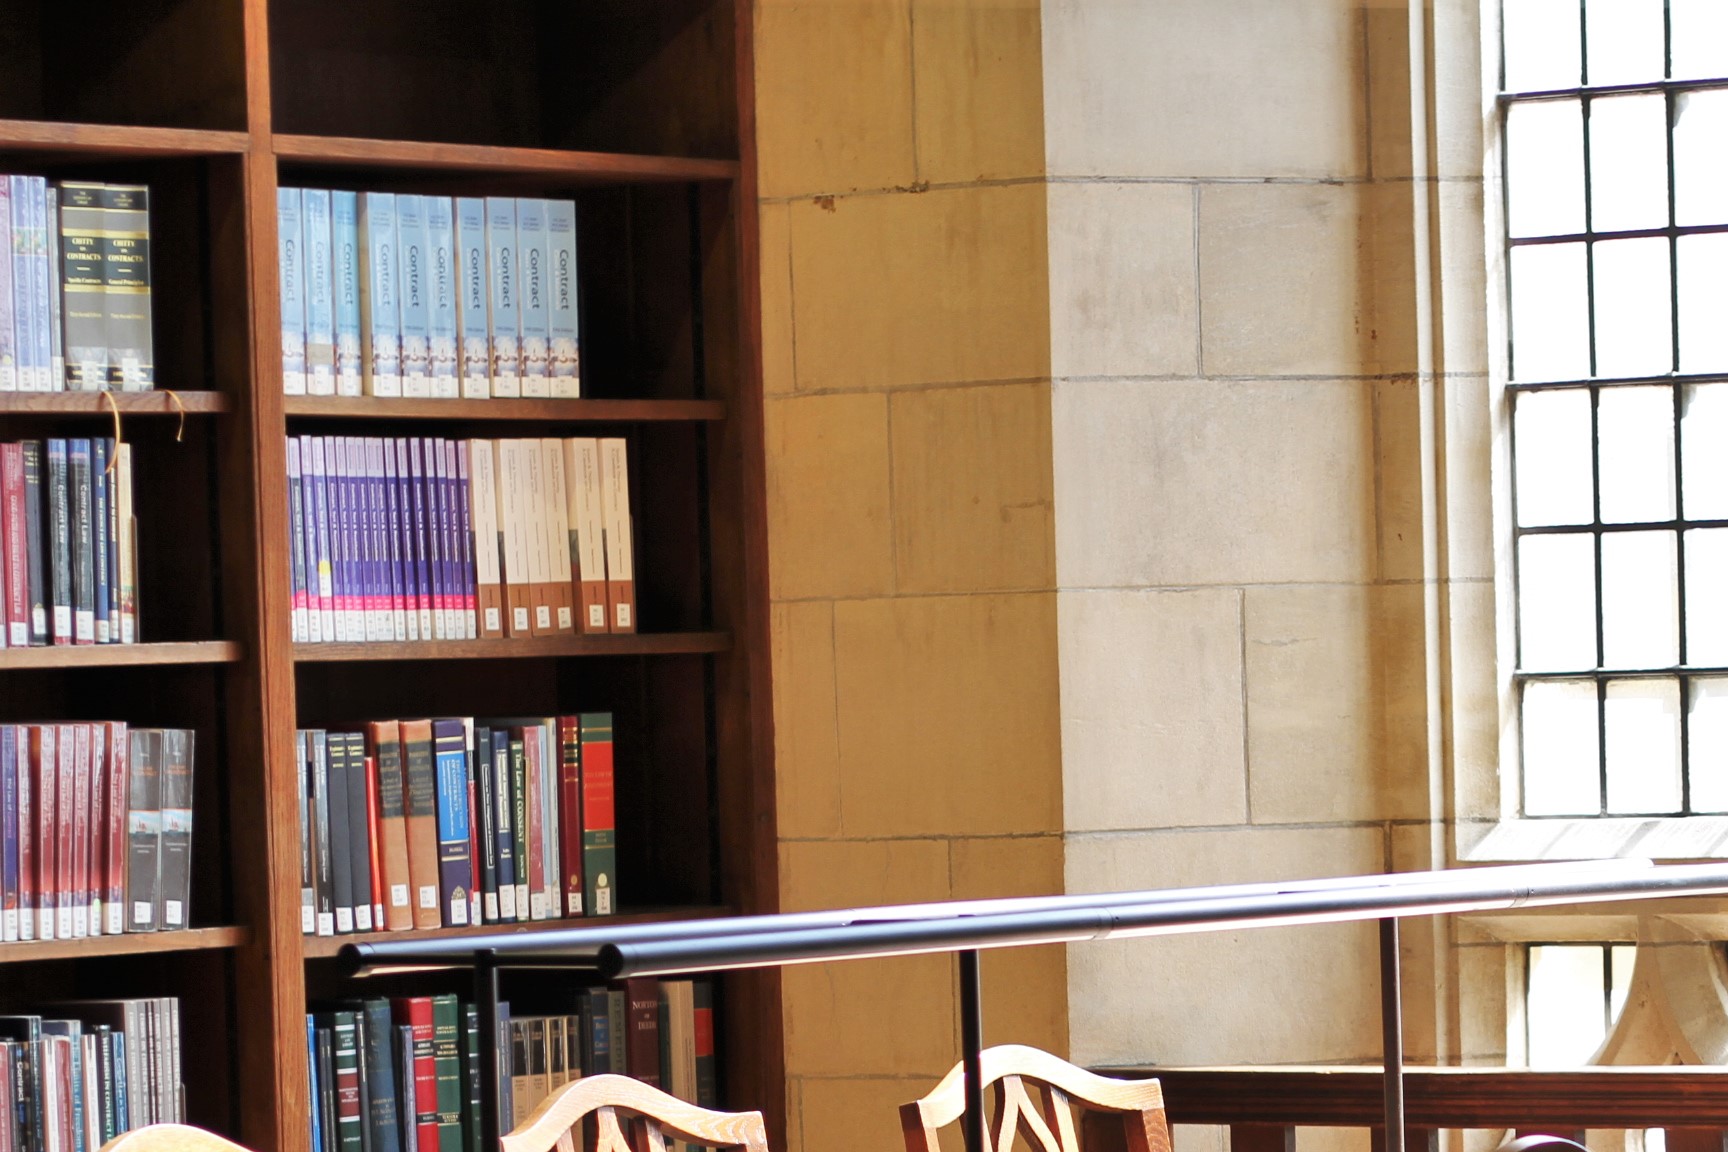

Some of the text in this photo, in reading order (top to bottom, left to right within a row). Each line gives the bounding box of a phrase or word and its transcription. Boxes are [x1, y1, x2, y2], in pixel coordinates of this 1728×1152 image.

[108, 254, 143, 262] CONTRACTS
[410, 245, 420, 307] Contract
[471, 248, 481, 309] Contract
[501, 247, 511, 309] Contract
[530, 248, 540, 309] Contract
[559, 249, 569, 310] Contract
[80, 484, 89, 544] Contract Law
[17, 1061, 25, 1102] Contract
[74, 1094, 82, 1105] of
[74, 1107, 84, 1147] Freedom
[104, 1091, 112, 1133] CONTRACT
